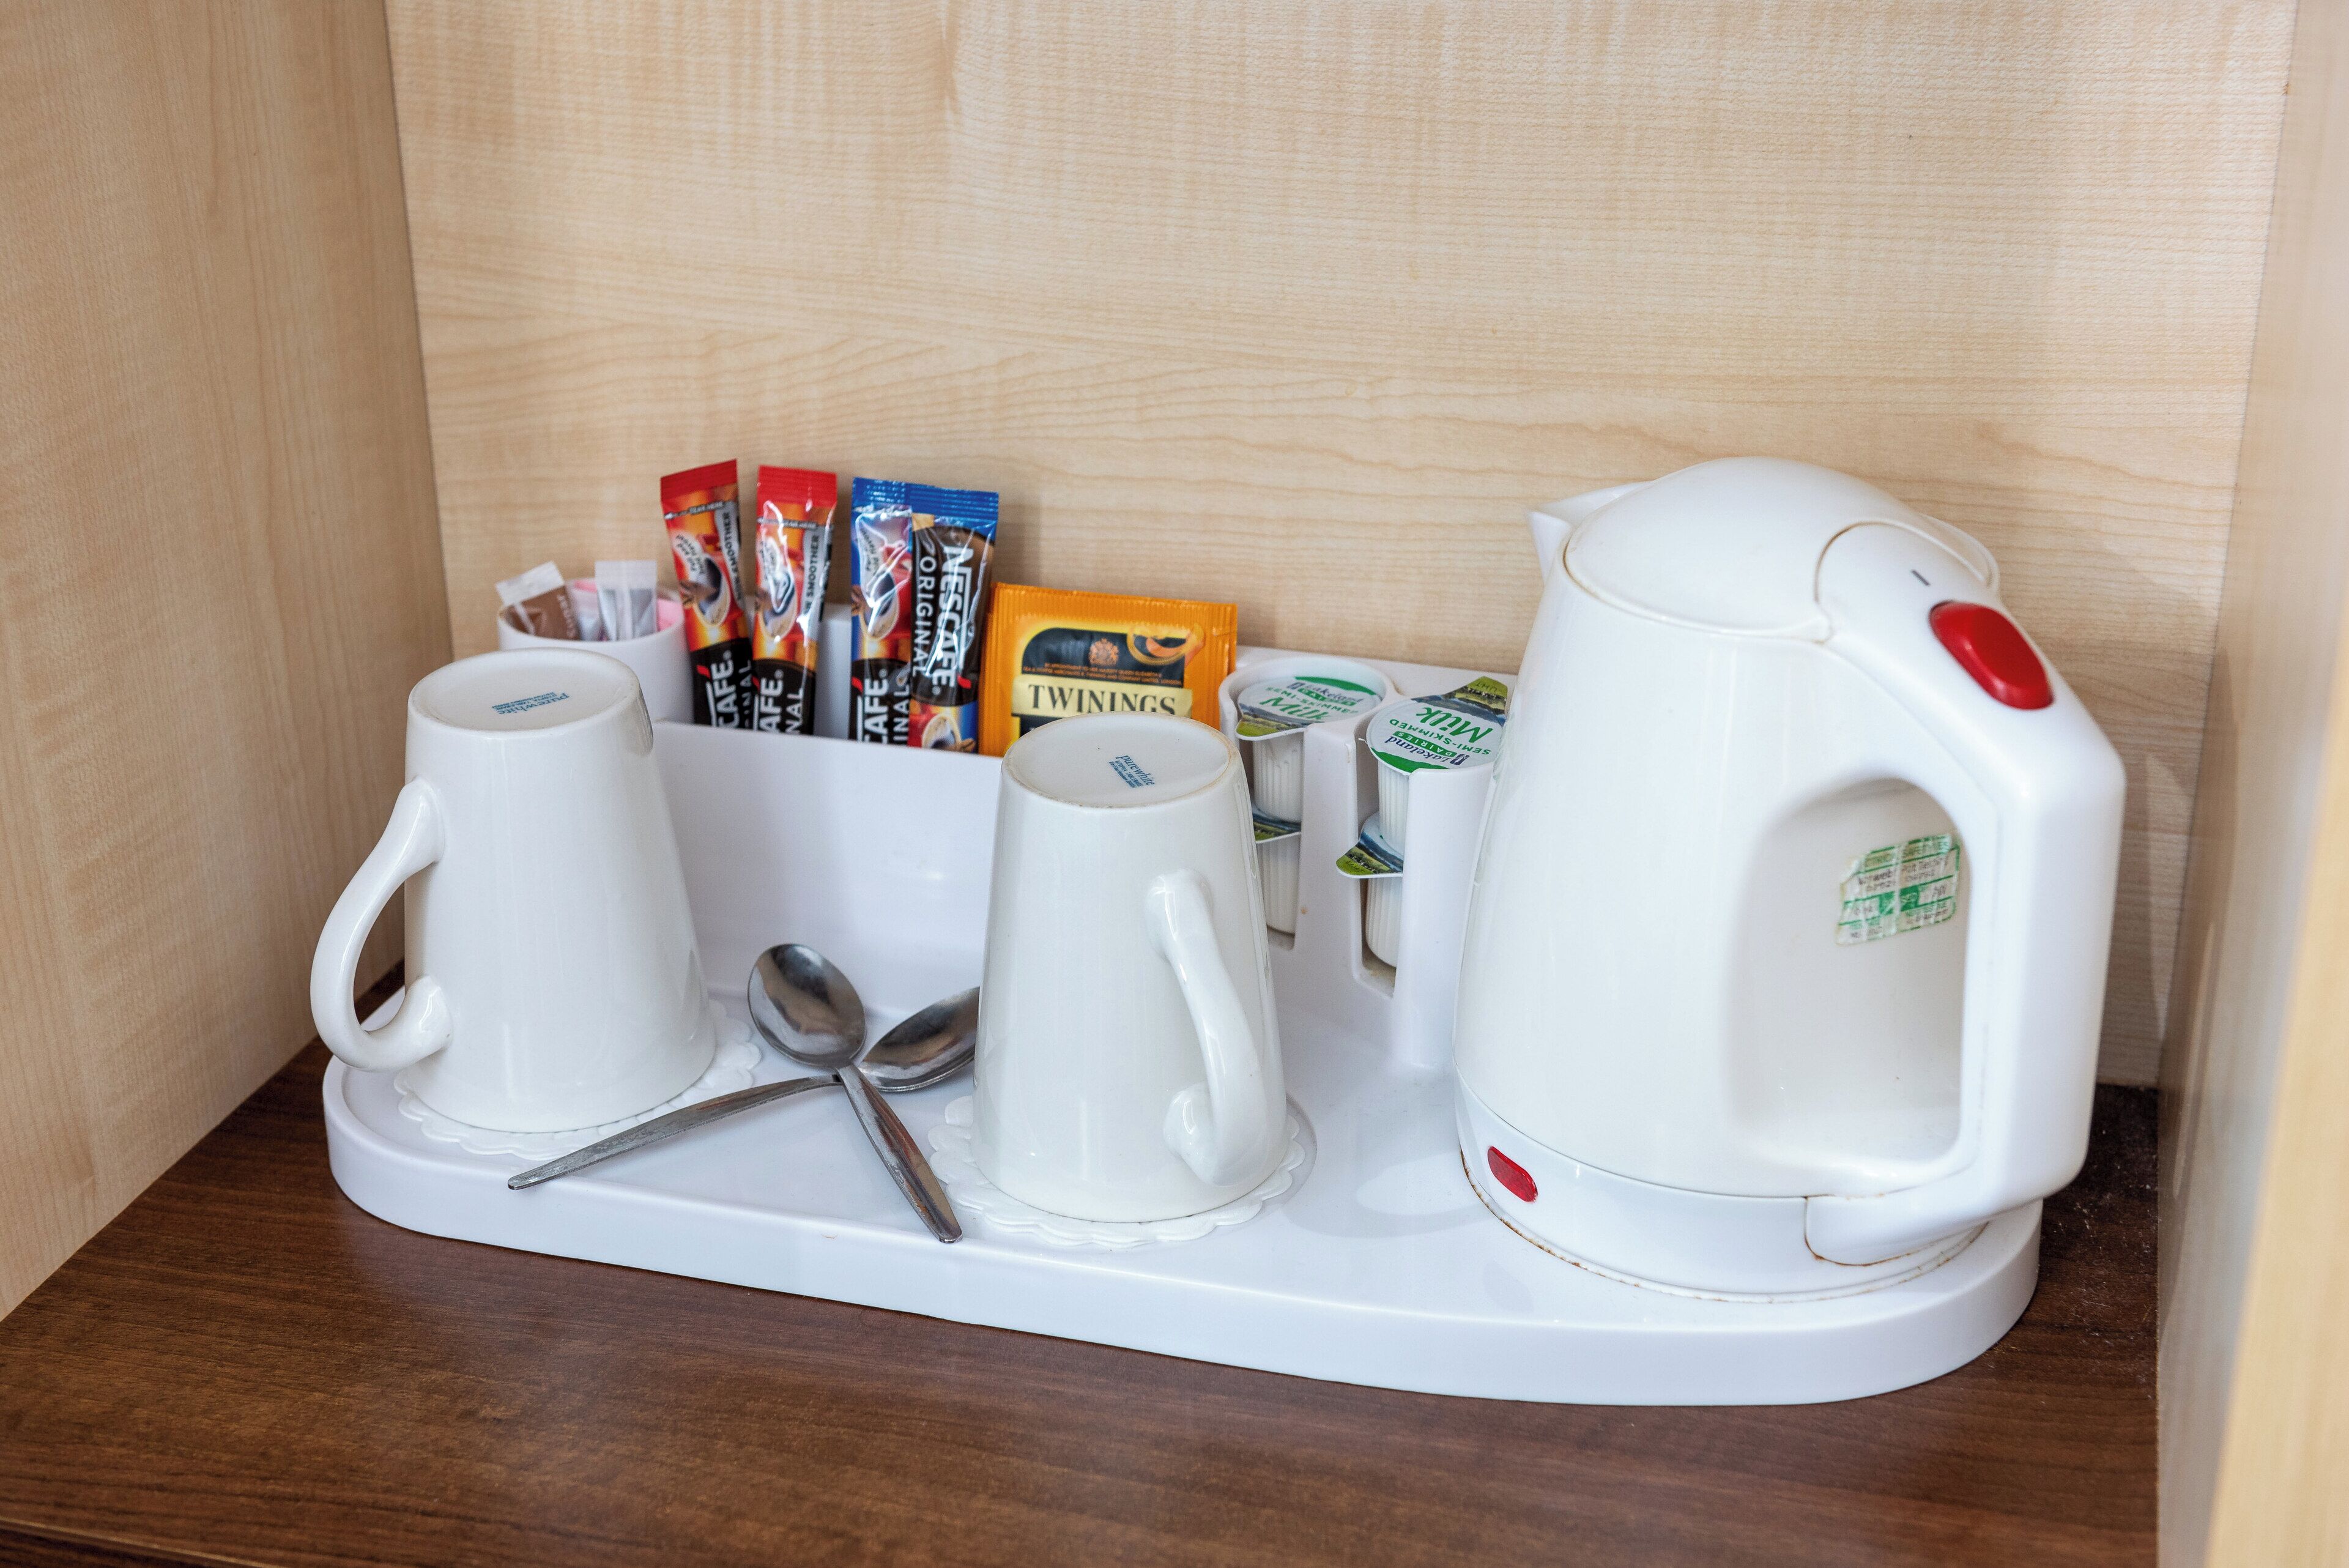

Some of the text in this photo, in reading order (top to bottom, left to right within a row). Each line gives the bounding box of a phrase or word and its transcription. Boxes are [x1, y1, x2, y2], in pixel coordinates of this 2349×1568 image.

[806, 535, 819, 597] SMOOTHER
[912, 556, 937, 676] ORIGINAL
[497, 692, 570, 715] purewhite
[1028, 684, 1176, 715] TWININGS
[1260, 696, 1330, 720] Milk
[1389, 718, 1491, 755] SEMI-SKIMMED
[1416, 707, 1494, 743] Milk
[1384, 735, 1451, 763] Lakeland
[1397, 732, 1453, 756] DAIRIES
[1115, 755, 1155, 786] purewhite
